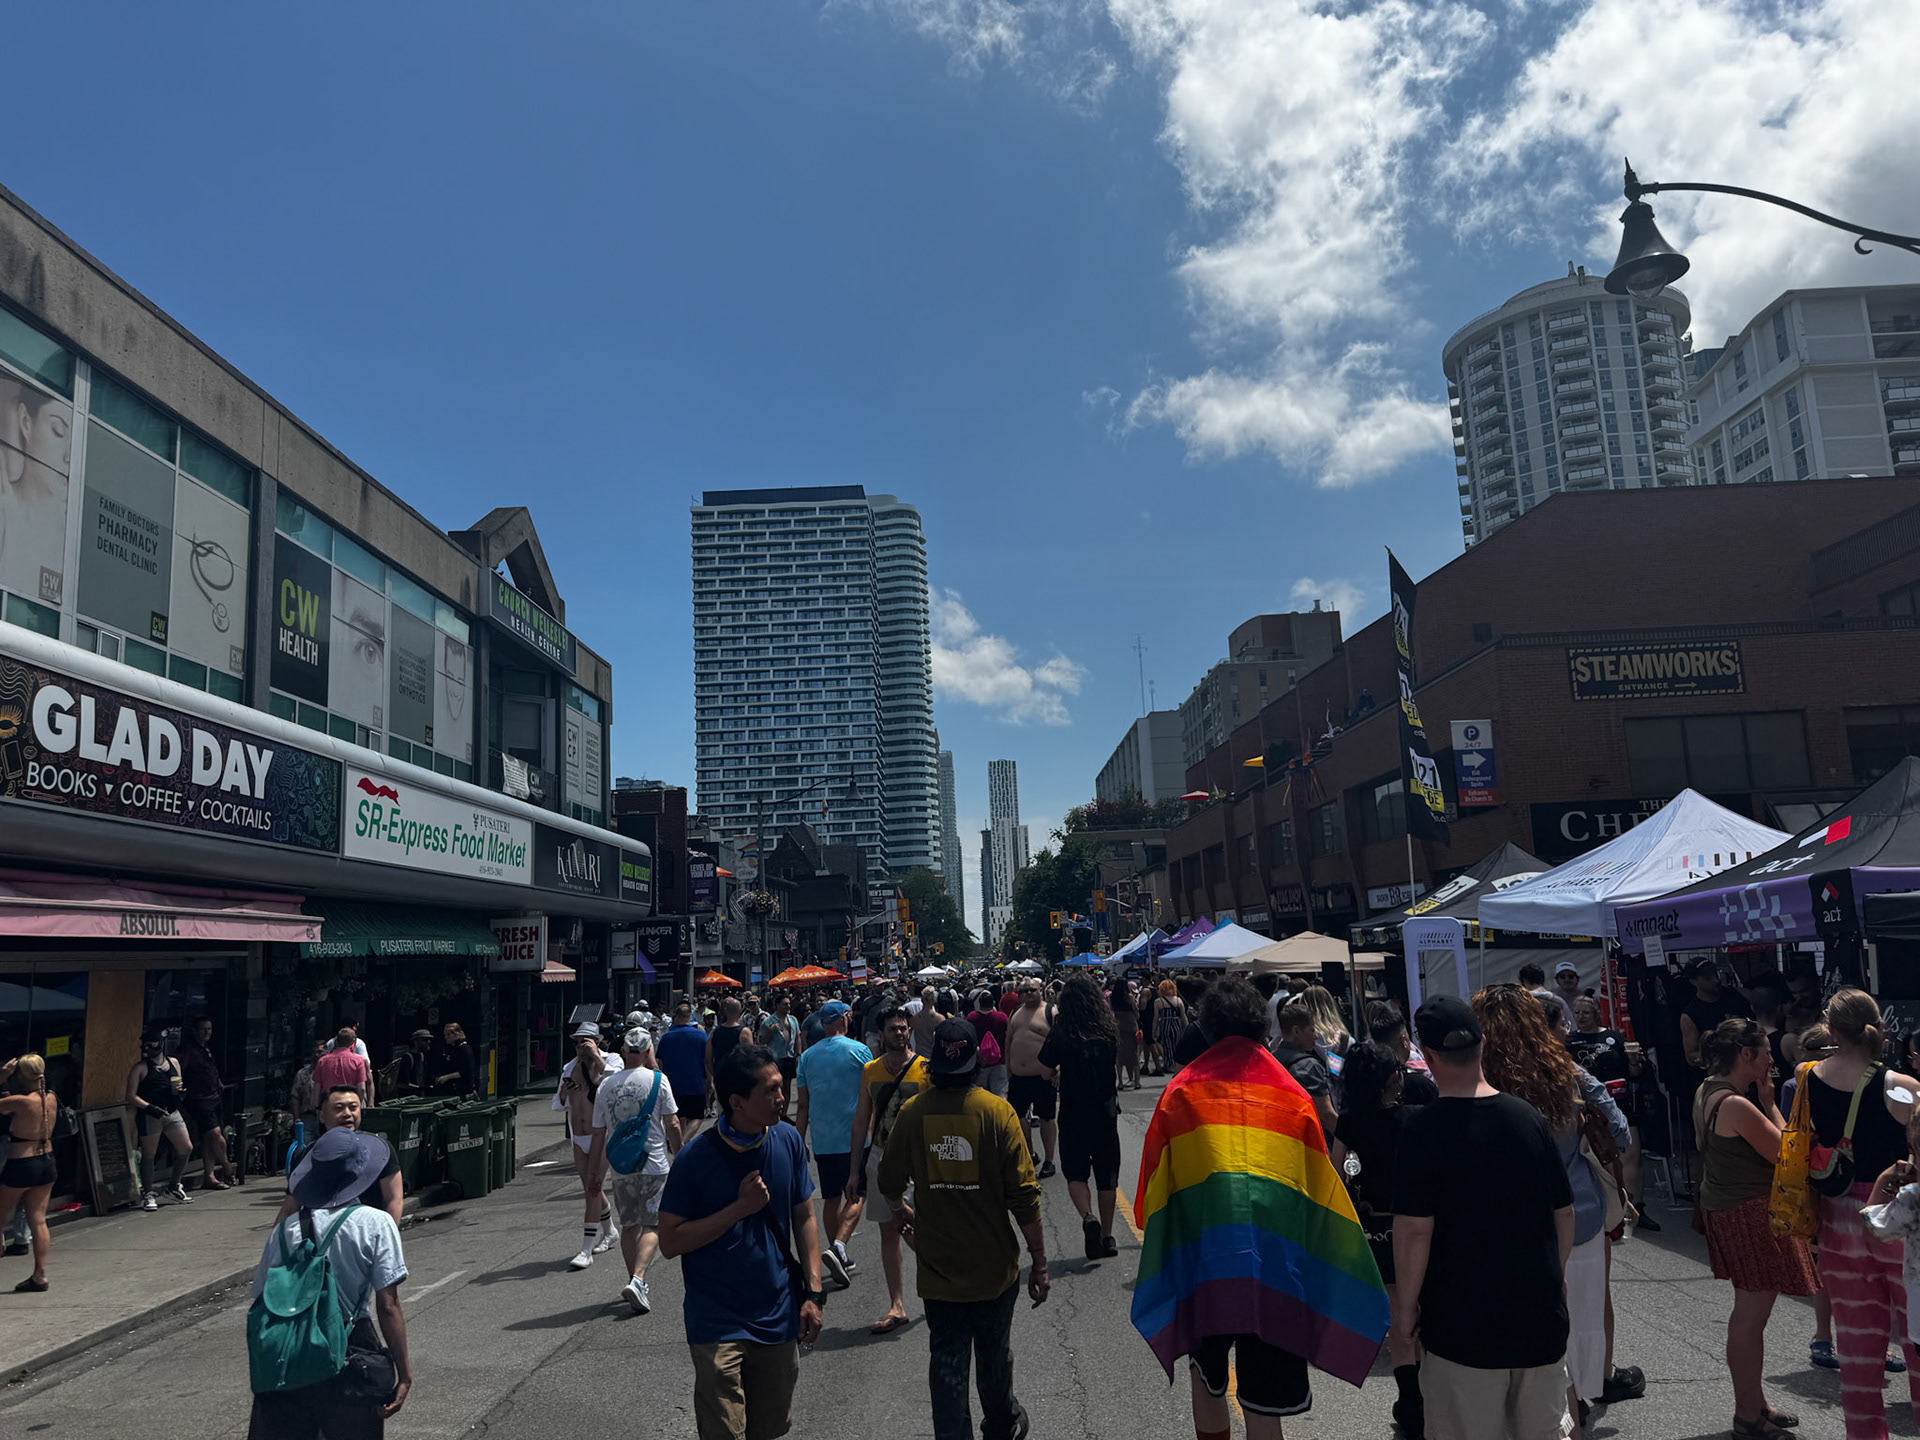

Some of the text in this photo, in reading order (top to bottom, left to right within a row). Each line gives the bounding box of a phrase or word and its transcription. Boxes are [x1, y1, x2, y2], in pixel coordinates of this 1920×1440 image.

[98, 496, 159, 537] FAMILY DOCTORS
[98, 513, 158, 556] PHARMACY
[97, 535, 158, 576] DENTAL CLINIC
[42, 572, 60, 591] CW
[280, 578, 319, 638] CW
[498, 582, 569, 653] CHURCH WELLESLEY
[152, 616, 166, 632] CW
[510, 614, 562, 661] HEALTH CENTRE
[279, 626, 319, 667] HEALTH
[1575, 649, 1738, 683] STEAMWORKS
[1618, 682, 1669, 692] ENTRANCE
[32, 684, 274, 800] GLAD DAY
[26, 761, 272, 832] BOOKS COFFEE COCKTAILS
[356, 799, 526, 868] SR-Express Food Market
[480, 814, 511, 834] PUSATERI
[1749, 852, 1816, 877] act
[1823, 904, 1842, 924] act
[308, 943, 352, 955] 416-923-2043
[380, 940, 415, 952] PUSATERI
[415, 940, 433, 952] FRUIT
[433, 940, 456, 952] MARKET
[457, 1139, 481, 1149] EVENTS
[930, 1144, 958, 1152] NORTH
[942, 1135, 958, 1144] THE
[938, 1152, 958, 1160] FACE
